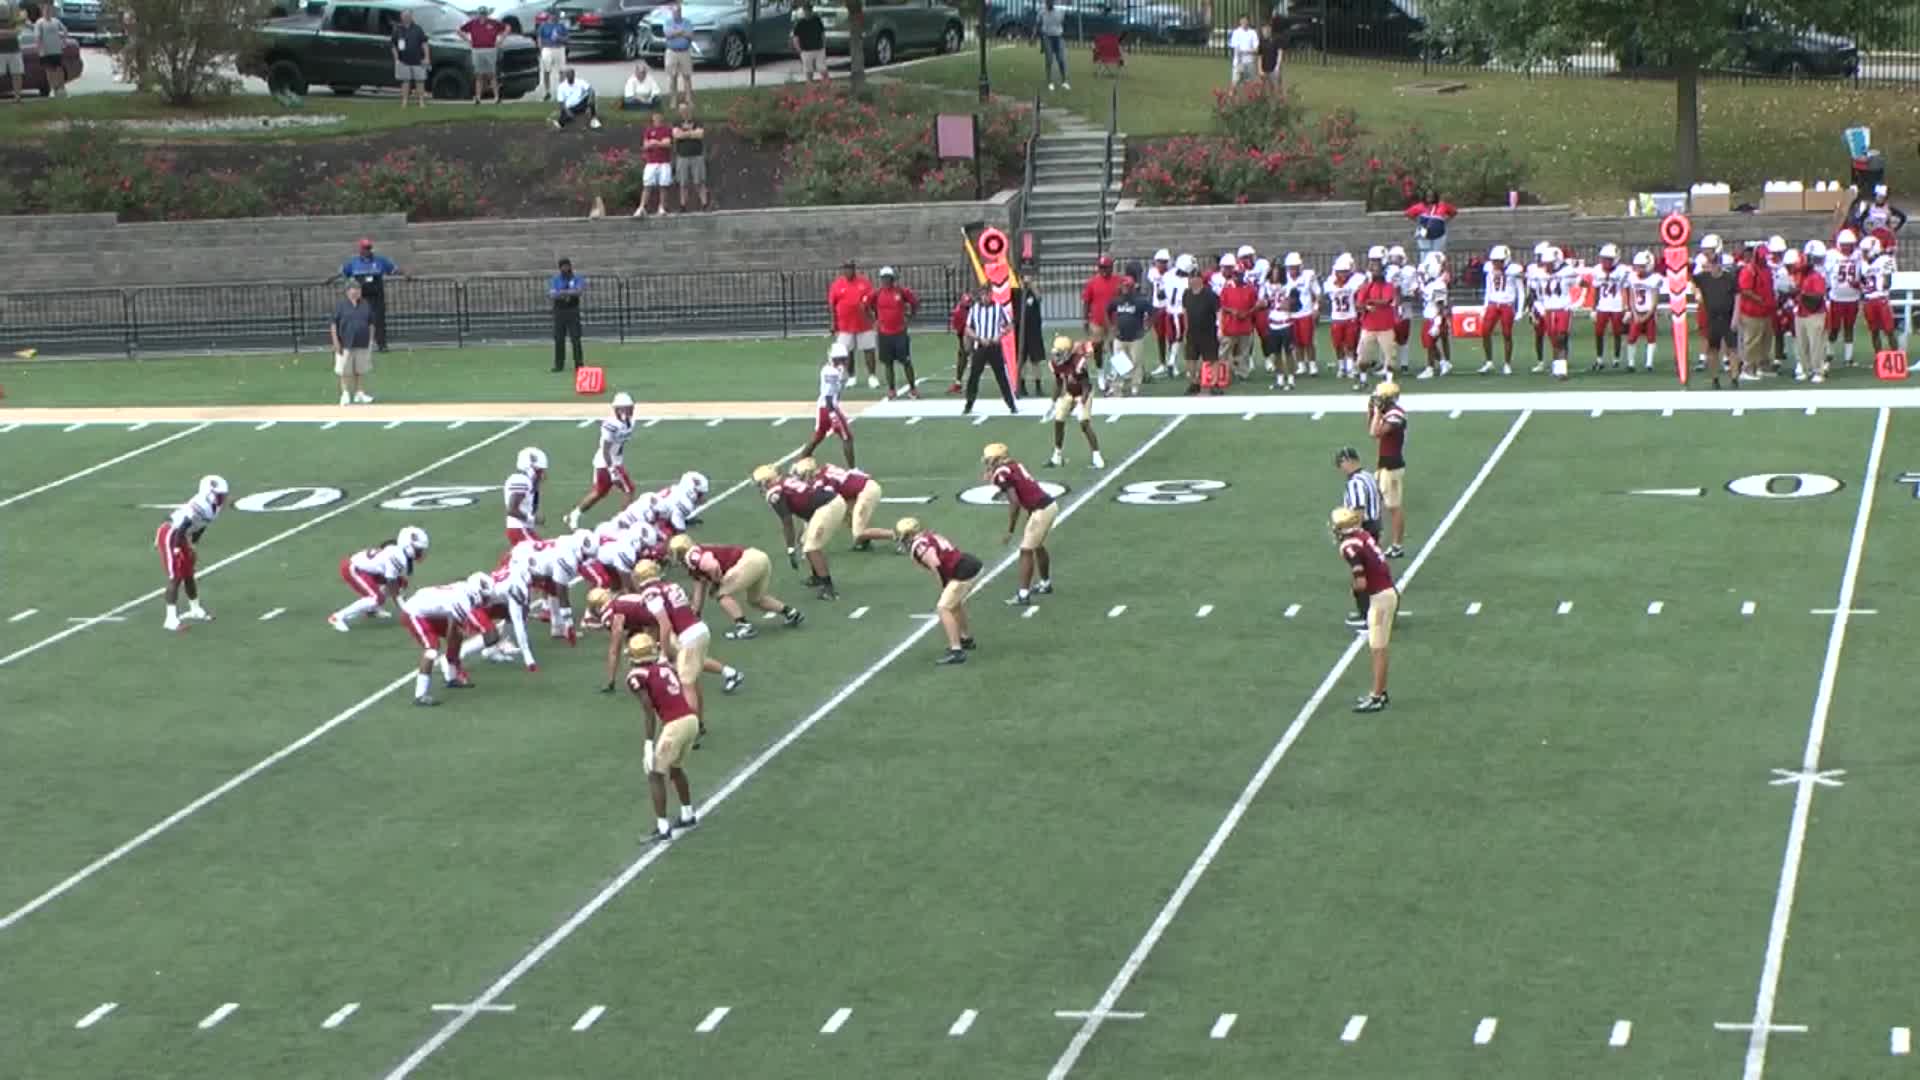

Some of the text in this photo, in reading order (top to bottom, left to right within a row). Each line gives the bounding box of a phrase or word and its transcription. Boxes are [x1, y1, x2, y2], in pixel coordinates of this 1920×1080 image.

[1462, 318, 1476, 332] G
[1884, 354, 1905, 375] 40
[580, 370, 600, 390] 20
[660, 667, 681, 696] 3
